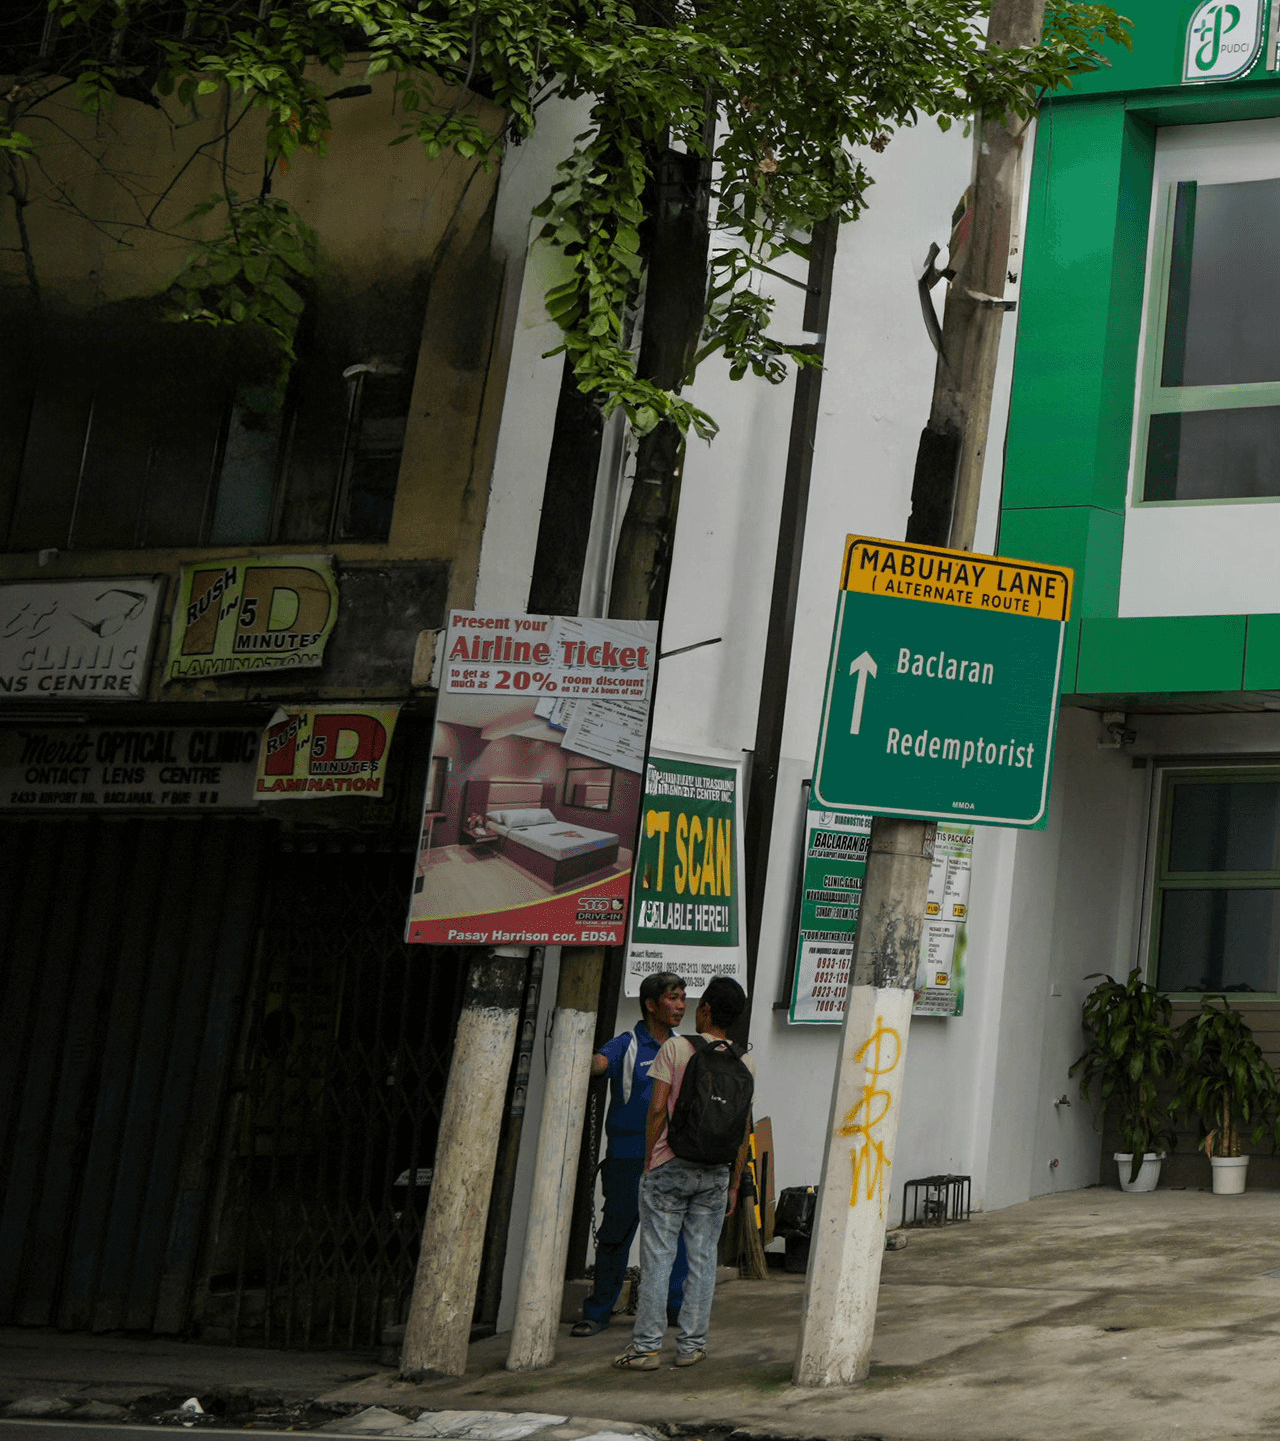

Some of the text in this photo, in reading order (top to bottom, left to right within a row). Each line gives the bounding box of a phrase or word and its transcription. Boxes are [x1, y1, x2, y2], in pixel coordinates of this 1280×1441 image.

[1221, 43, 1249, 53] PUDCI
[860, 548, 1057, 599] MABUHAY LANE
[187, 566, 237, 626] RUSH
[885, 579, 973, 605] ALTERNATE
[981, 594, 1030, 613] ROUTE
[219, 595, 258, 627] IN 5
[453, 615, 548, 632] Present your
[237, 633, 321, 649] MINUTES
[449, 635, 649, 669] Airline Ticket
[451, 669, 460, 677] to
[463, 669, 478, 679] get
[897, 647, 994, 685] Baclaran
[37, 675, 132, 691] CENTRE
[451, 679, 488, 689] much as
[495, 670, 558, 692] 20%
[562, 676, 644, 687] room discount
[601, 686, 620, 695] hours
[630, 688, 644, 696] stay
[266, 713, 307, 755] RUSH
[17, 730, 94, 765] Merit
[95, 730, 176, 764] OPTICAL
[296, 735, 327, 757] IN 5
[886, 727, 1035, 769] Redemptorist
[311, 760, 379, 773] MINUTES
[25, 767, 222, 784] ONTACT LENS CENTRE
[695, 776, 734, 791] ULTRASOUND
[257, 777, 380, 792] LAMINATION
[38, 791, 77, 804] AIRPORT
[696, 789, 720, 801] CENTER
[952, 801, 975, 810] MMDA
[834, 815, 863, 827] DIAGNOSTIC
[814, 832, 858, 851] BACLARAN
[674, 813, 731, 897] SCAN
[695, 905, 729, 932] HERE!!
[816, 907, 832, 917] SUNDAY
[448, 929, 617, 943] Pasay Harrison cor. EDSA
[820, 932, 840, 940] PARTNER
